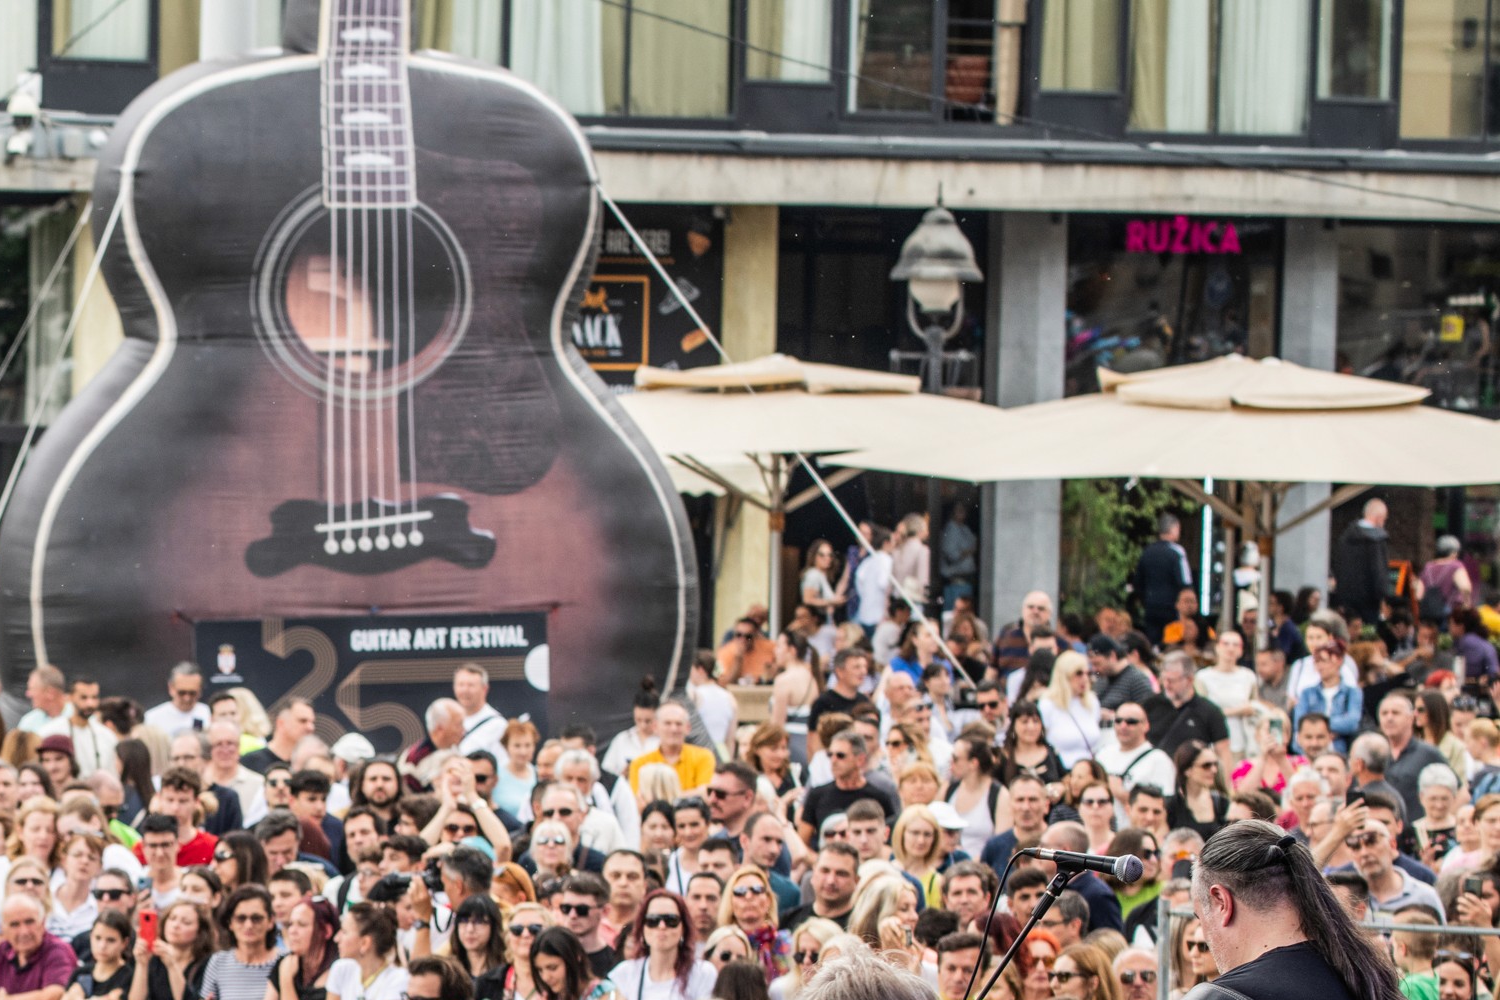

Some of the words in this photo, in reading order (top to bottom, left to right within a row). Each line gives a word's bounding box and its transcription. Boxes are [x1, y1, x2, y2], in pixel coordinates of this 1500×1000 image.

[1125, 215, 1241, 252] RUŽICA
[350, 627, 409, 652] GUITAR
[413, 626, 448, 650] ART
[449, 624, 528, 649] FESTIVAL
